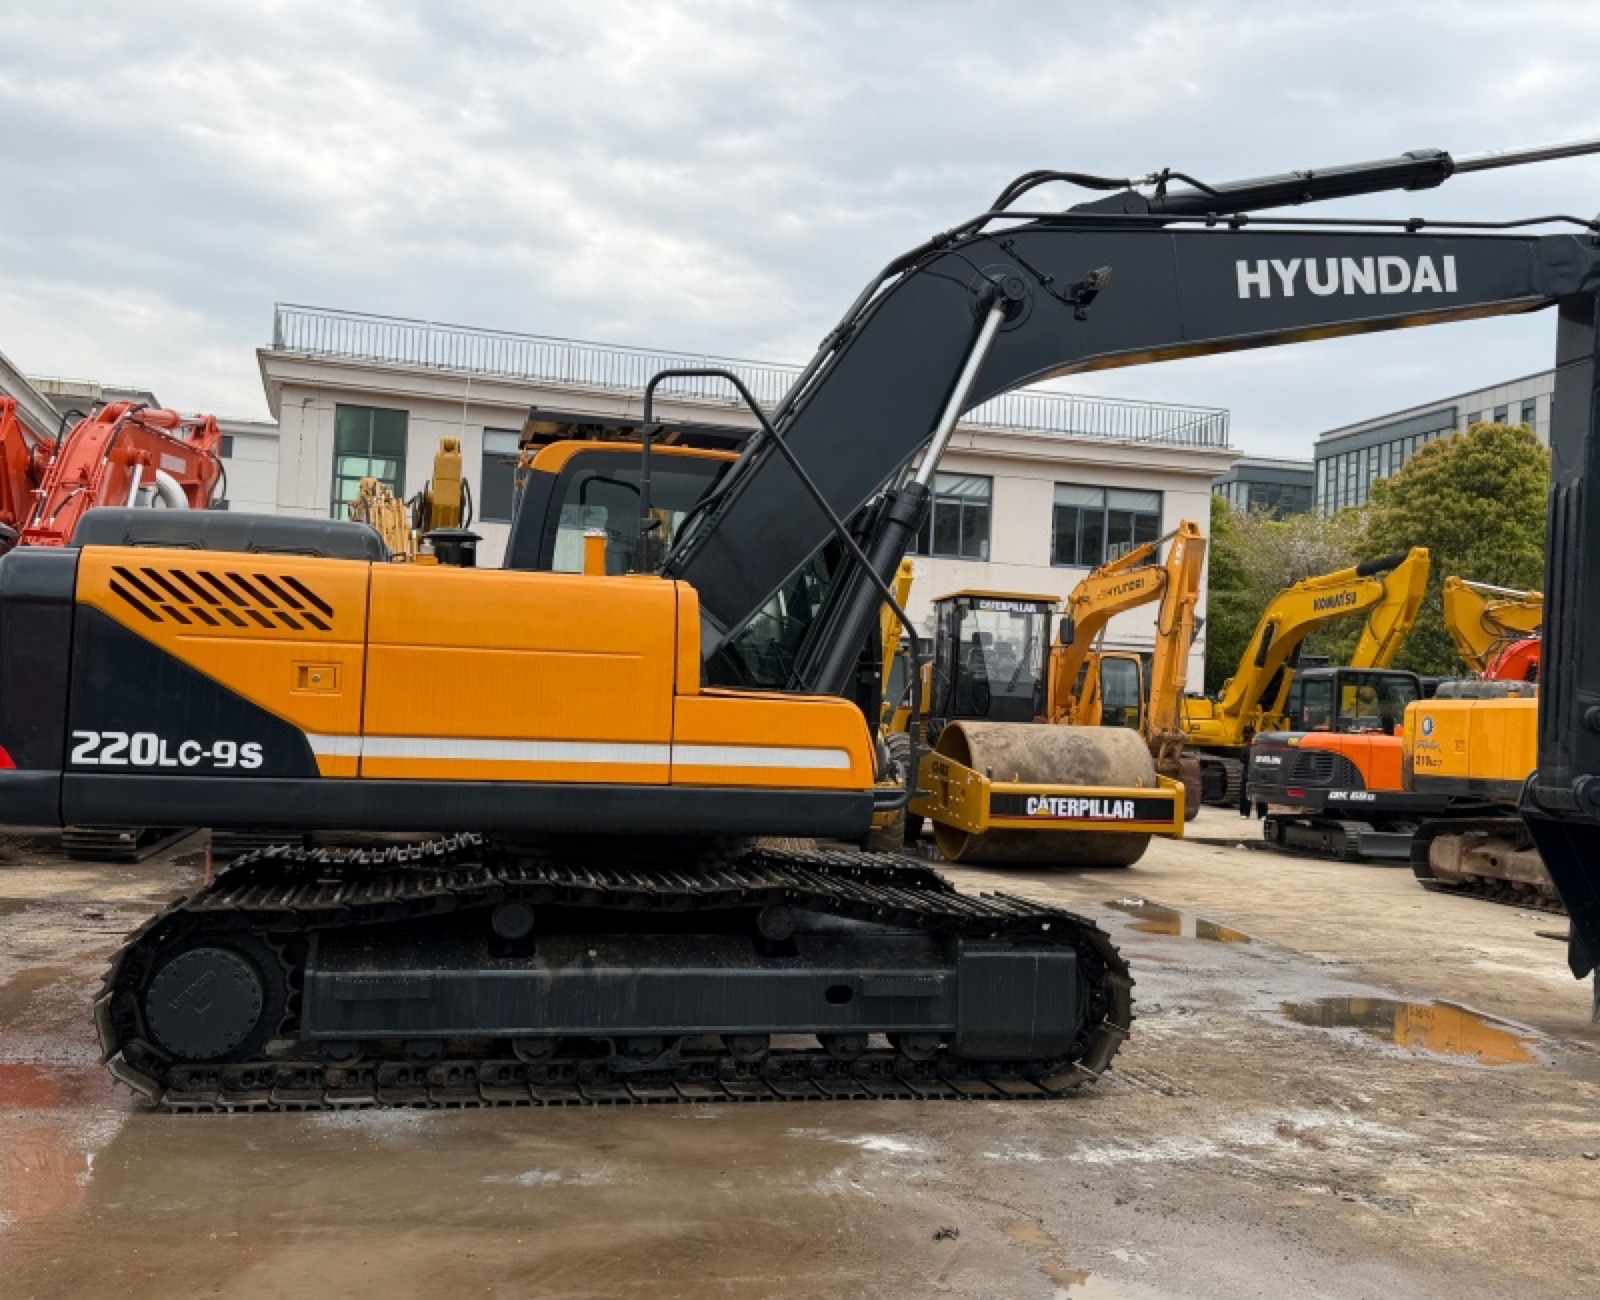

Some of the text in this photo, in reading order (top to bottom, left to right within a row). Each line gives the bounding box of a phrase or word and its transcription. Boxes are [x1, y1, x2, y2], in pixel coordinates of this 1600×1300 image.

[1236, 254, 1457, 298] HYUNDAI
[979, 600, 1036, 612] CATERPILLAR
[1313, 591, 1356, 612] KOMATSU
[71, 731, 263, 768] 220LC-9S
[1026, 797, 1135, 819] CATERPILLAR
